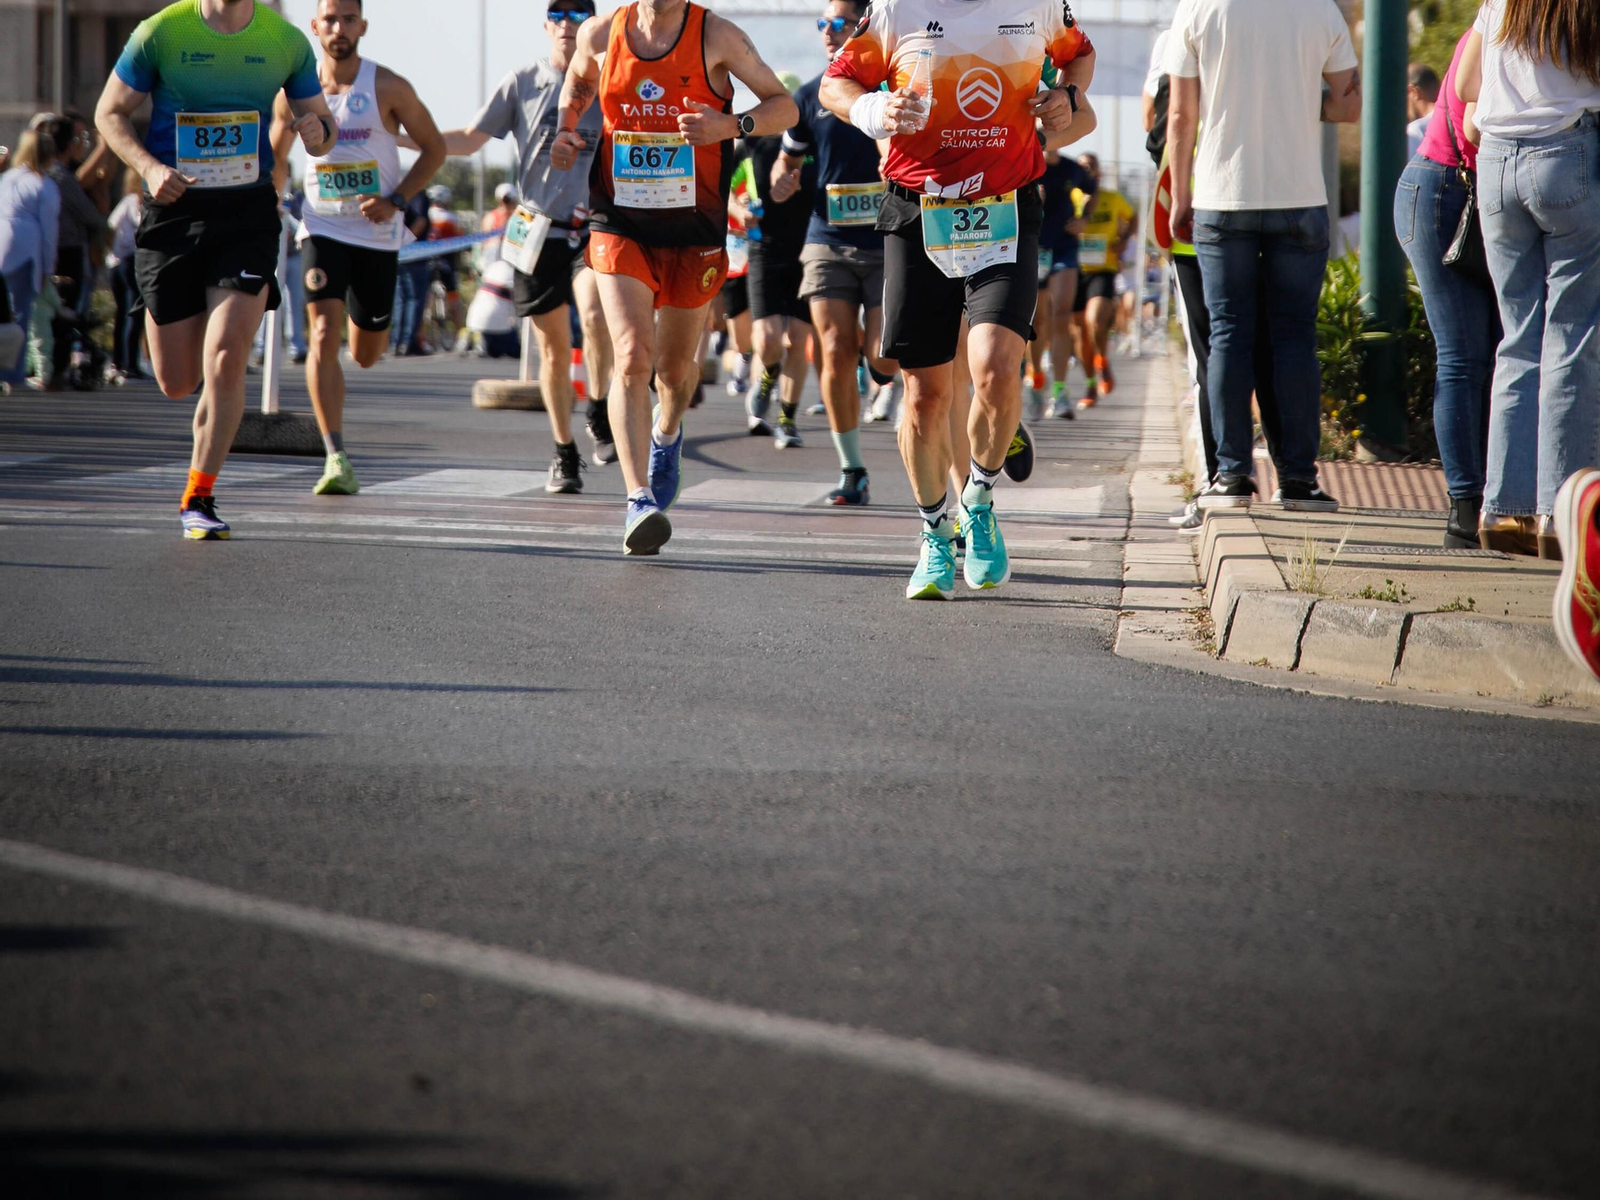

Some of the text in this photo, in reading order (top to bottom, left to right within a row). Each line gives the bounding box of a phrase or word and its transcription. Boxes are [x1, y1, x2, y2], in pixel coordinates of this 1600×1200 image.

[620, 103, 680, 117] TARSO
[195, 125, 243, 148] 823
[338, 128, 372, 140] INING
[986, 138, 1006, 148] CAR
[629, 146, 679, 168] 667
[323, 170, 374, 189] 2088
[952, 206, 990, 231] 32
